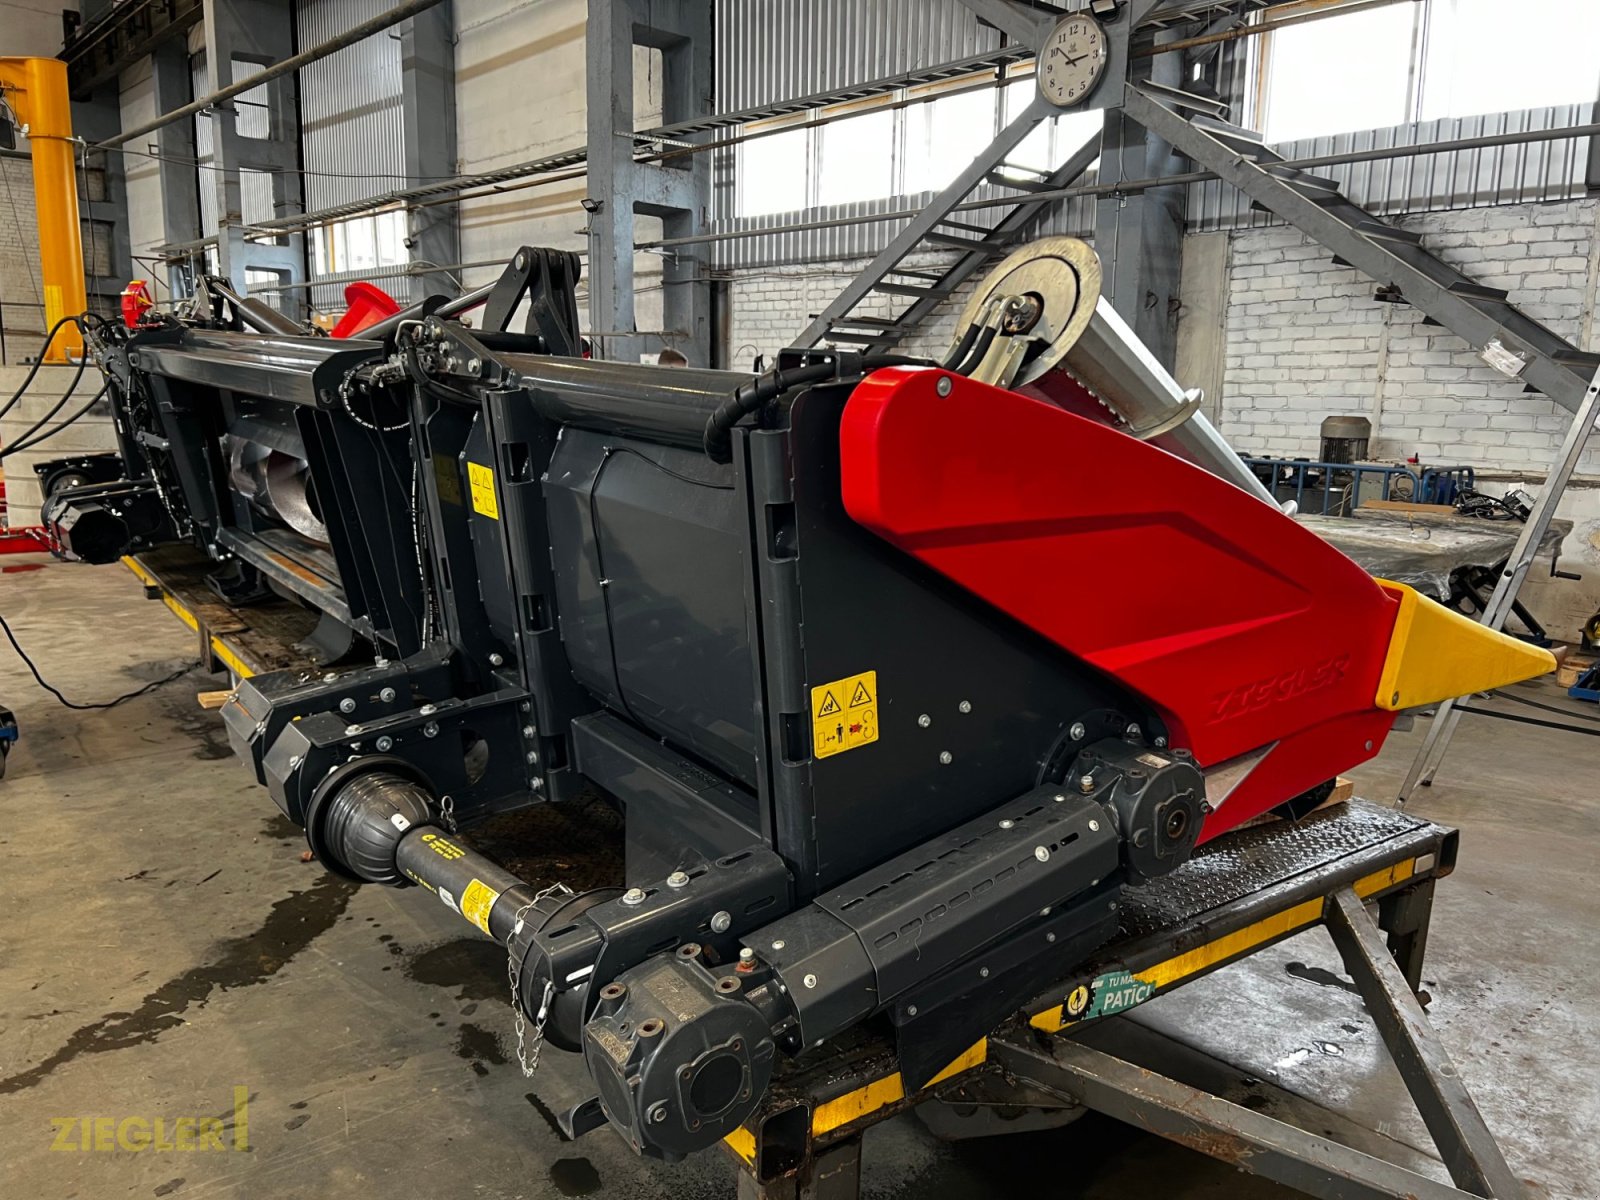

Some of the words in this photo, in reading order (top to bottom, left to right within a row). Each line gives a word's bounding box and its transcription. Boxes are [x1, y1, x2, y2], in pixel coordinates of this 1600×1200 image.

[1069, 24, 1079, 36] 12
[1058, 33, 1066, 44] 11
[1050, 47, 1059, 58] 10
[1204, 652, 1350, 726] ZIEGLER
[1109, 976, 1119, 988] TU
